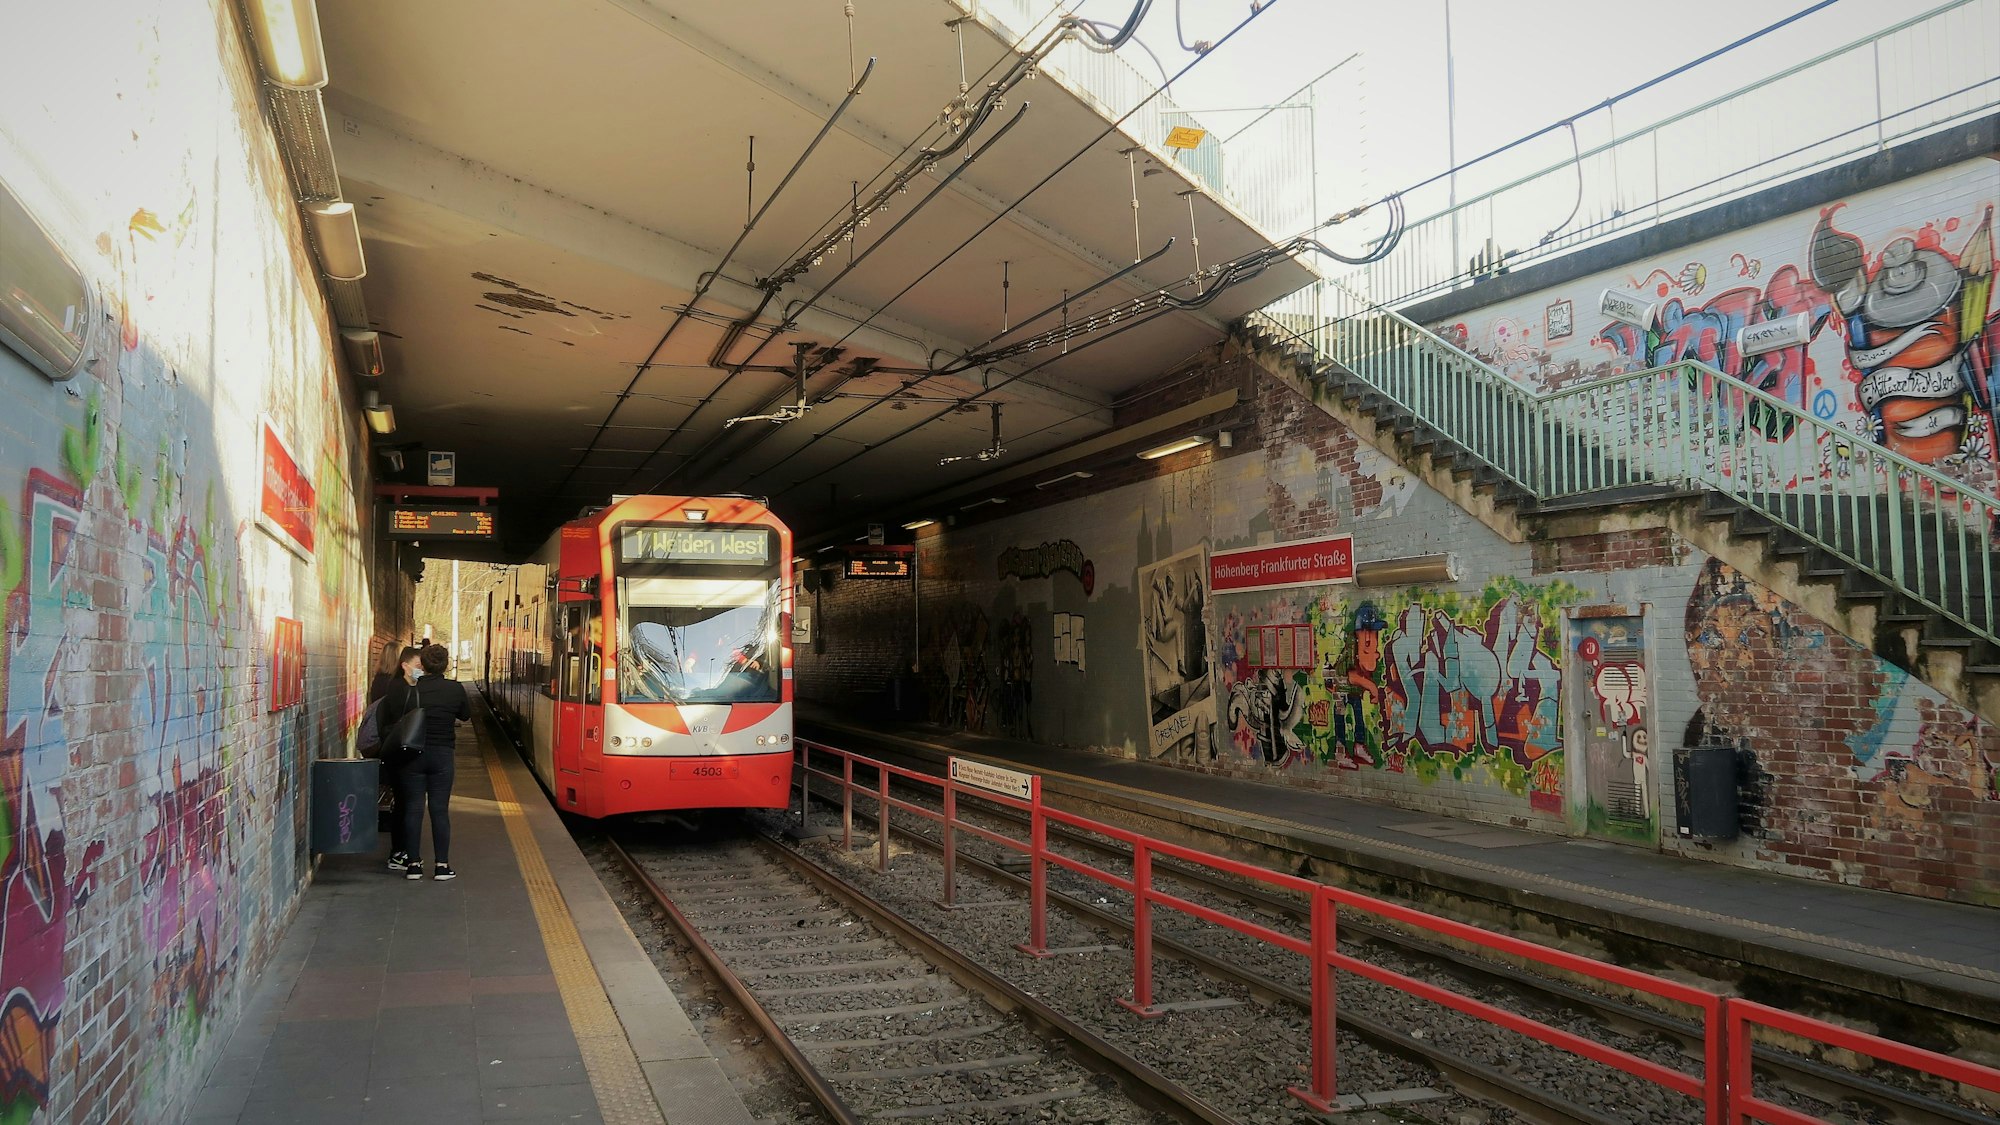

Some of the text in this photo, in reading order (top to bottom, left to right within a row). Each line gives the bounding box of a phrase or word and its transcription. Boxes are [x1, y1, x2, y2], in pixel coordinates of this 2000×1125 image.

[652, 532, 715, 554] Weiden
[721, 534, 765, 555] West
[1214, 549, 1347, 578] Höhenberg Frankfurter Straße
[692, 725, 709, 733] KVB
[692, 767, 723, 777] 4503
